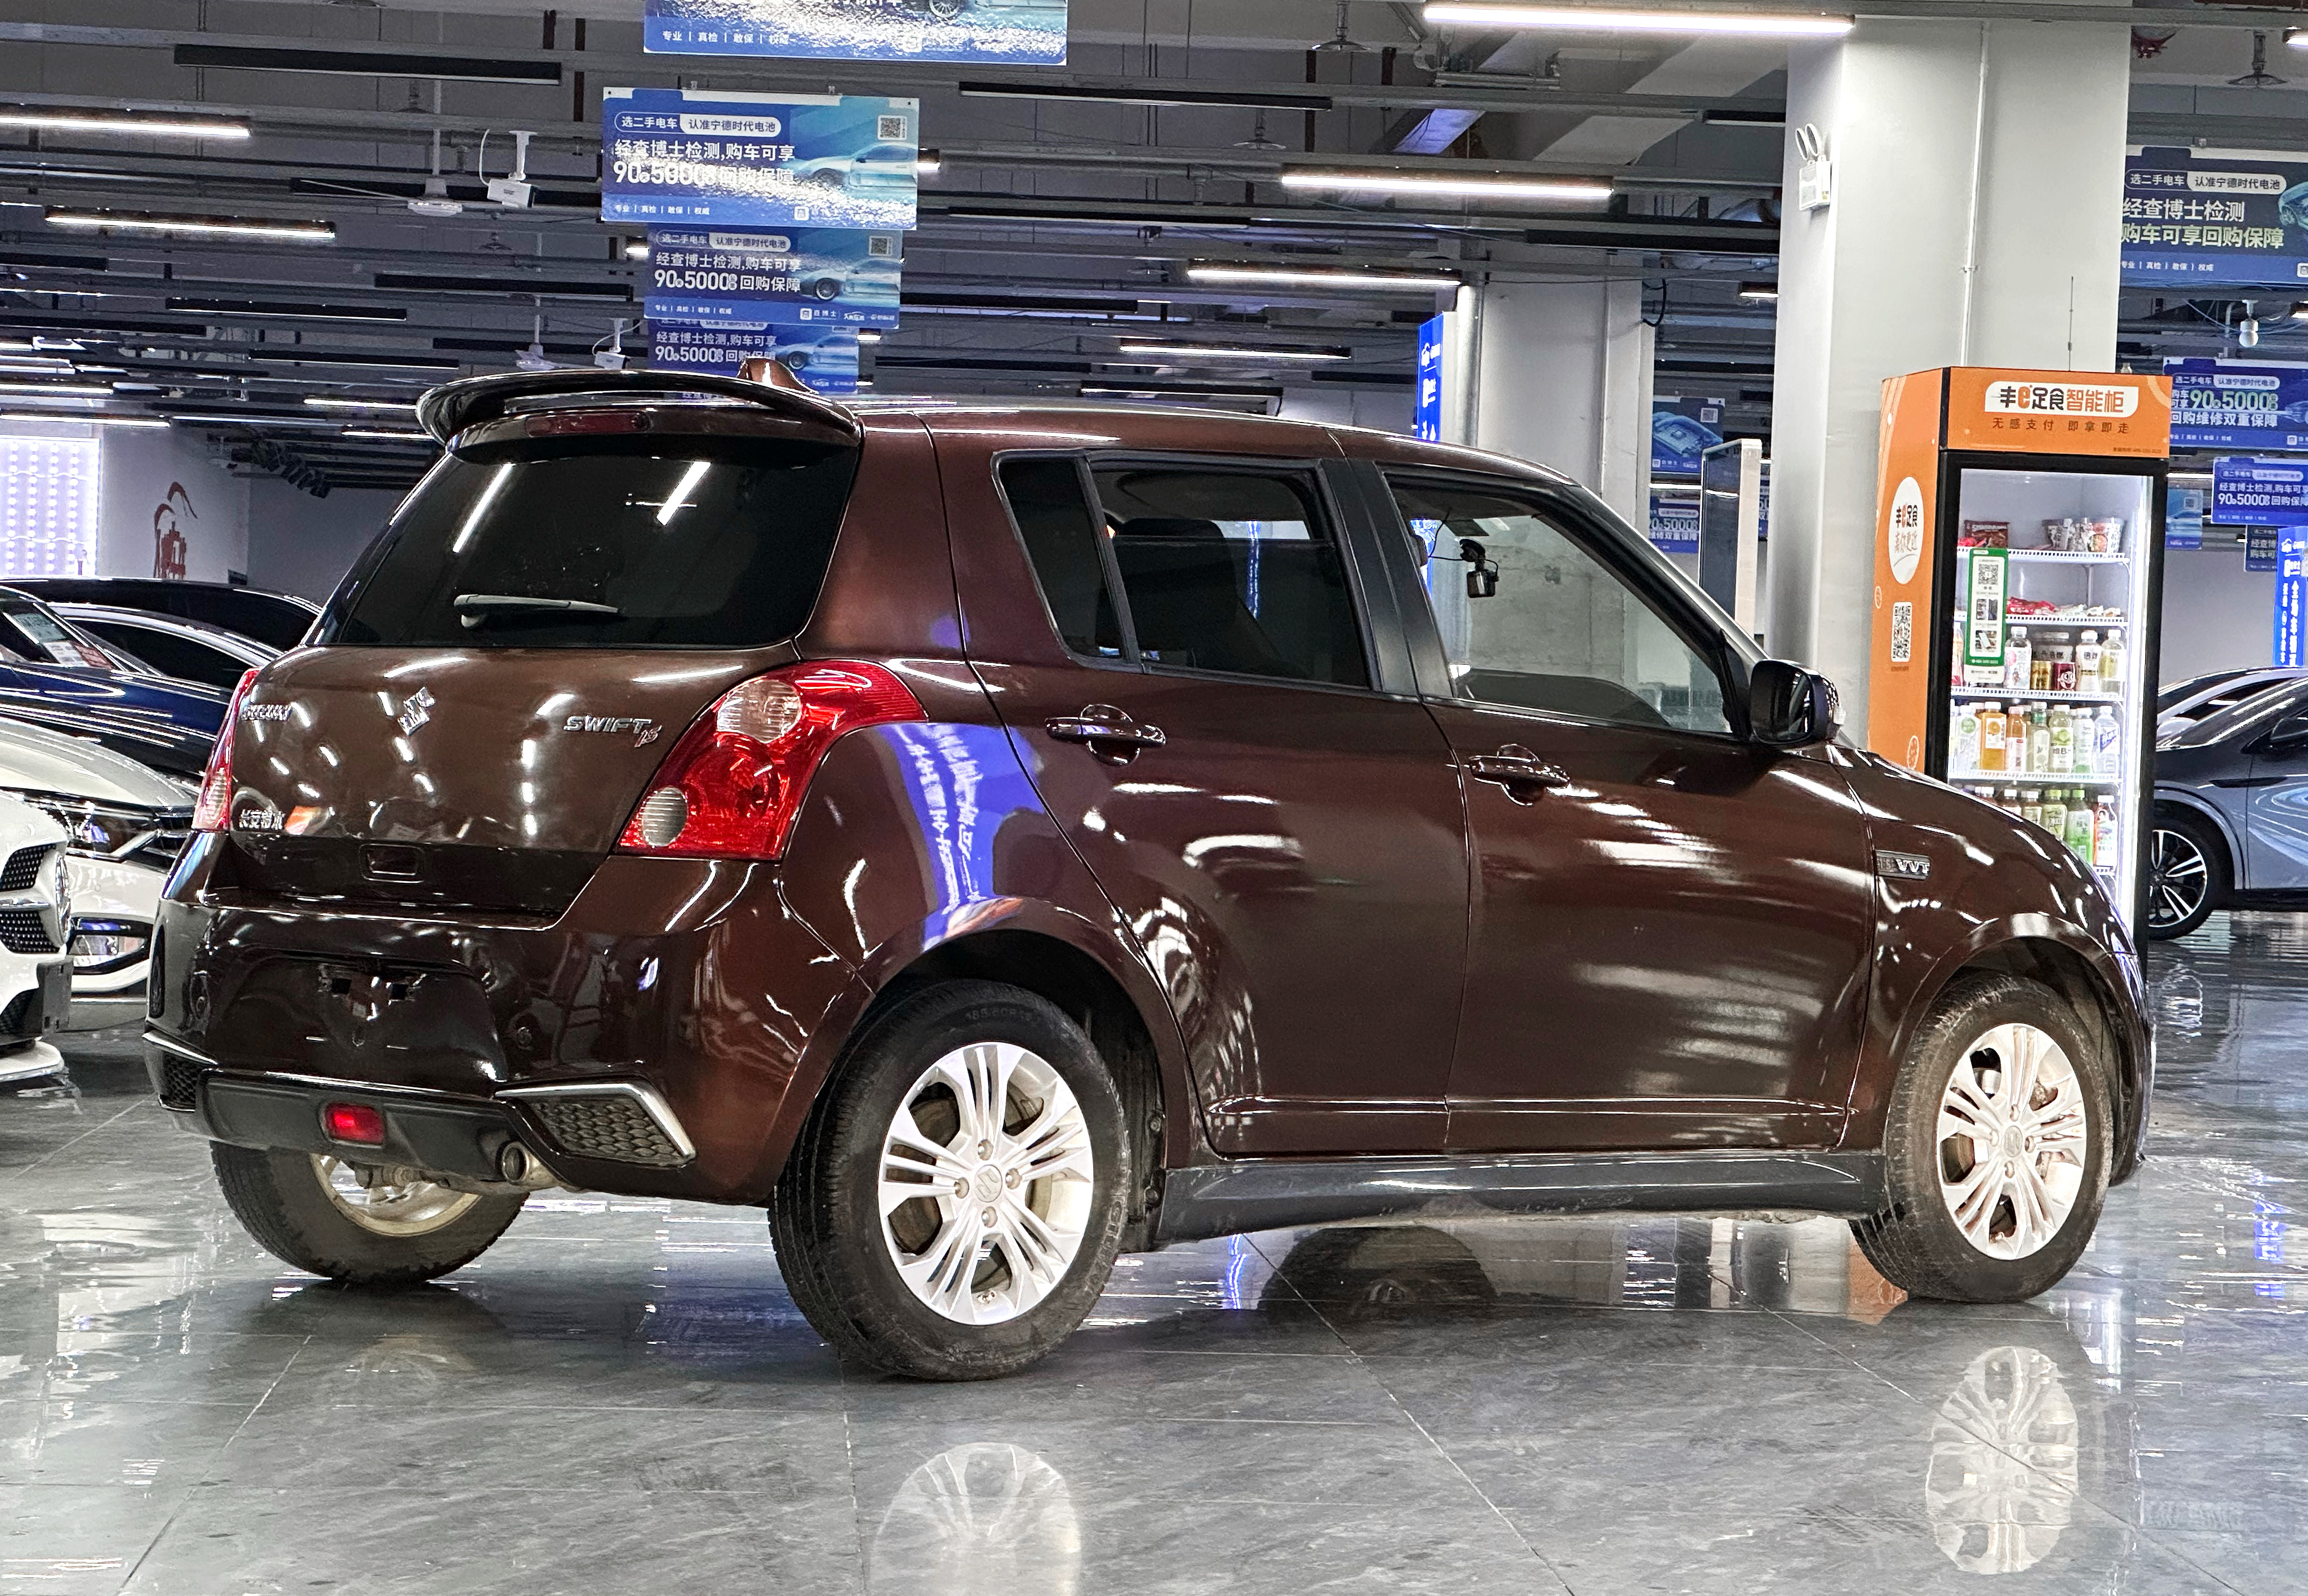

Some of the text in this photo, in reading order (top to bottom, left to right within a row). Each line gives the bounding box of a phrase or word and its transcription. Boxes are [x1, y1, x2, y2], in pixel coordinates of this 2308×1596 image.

[663, 30, 682, 41] 专业
[698, 32, 718, 42] 真检
[734, 33, 753, 43] 敢保
[622, 116, 776, 132] 选二手电车 认准宁德时代电池
[614, 139, 796, 162] 经查博士检测,购车可享
[2131, 173, 2280, 190] 选二手电车 认准宁德时代电池
[2123, 198, 2245, 222] 经查博士检测
[717, 237, 786, 249] 认准宁德时代电池
[2121, 223, 2284, 248] 购车可享回购保障
[656, 252, 801, 272] 经查博士检测,购车可享
[656, 331, 777, 346] 经查博士检测,购车可享
[1992, 417, 2129, 434] 无感支付 即拿即走
[2171, 411, 2278, 427] 回购维修双重保障
[563, 715, 653, 734] SWIFT
